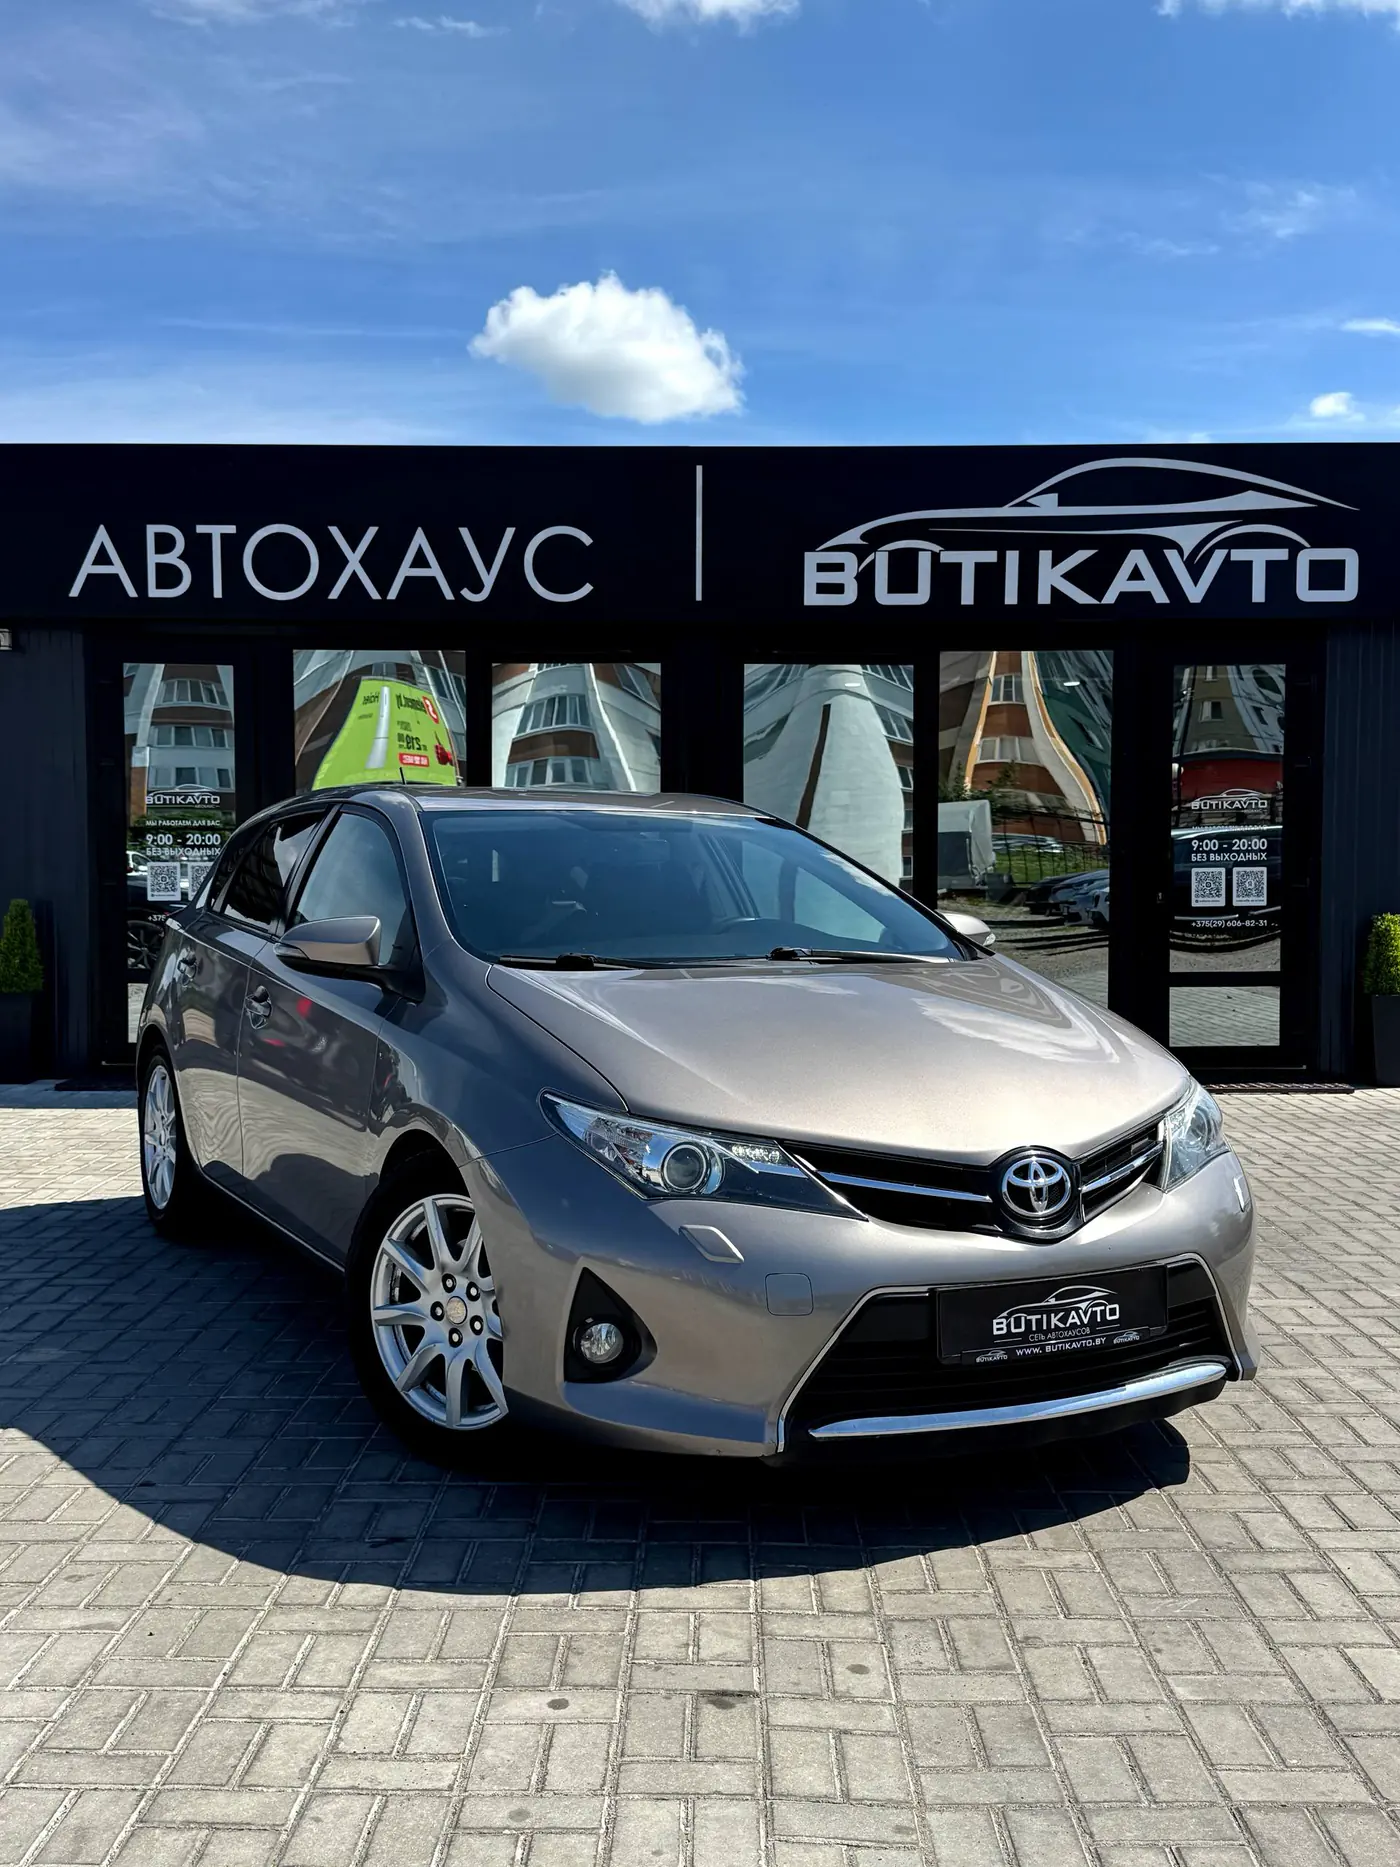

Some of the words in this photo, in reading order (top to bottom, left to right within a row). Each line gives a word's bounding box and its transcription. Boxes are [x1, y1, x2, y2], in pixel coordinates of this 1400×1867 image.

[68, 524, 594, 603] АВТОХАУС
[804, 547, 1360, 606] BUTIKAVTO
[145, 795, 220, 804] BUTIKAVTO
[1191, 800, 1268, 810] BUTIKAVTO
[146, 834, 173, 846] 9:00
[186, 834, 220, 845] 20:00
[1191, 840, 1218, 851] 9:00
[1232, 839, 1268, 850] 20:00
[146, 848, 164, 856] БЕЗ
[165, 847, 220, 856] ВЫХОДНЫХ
[1191, 854, 1207, 862] БЕЗ
[1210, 852, 1267, 862] ВЫХОДНЫХ
[992, 1304, 1120, 1336] BUTIKAVTO
[1028, 1333, 1046, 1342] СЕТЬ
[1047, 1327, 1090, 1340] АВТОХАУСОВ
[1045, 1337, 1106, 1353] BUTIKAVTO.BY
[976, 1354, 1008, 1363] BUTIKAVTO
